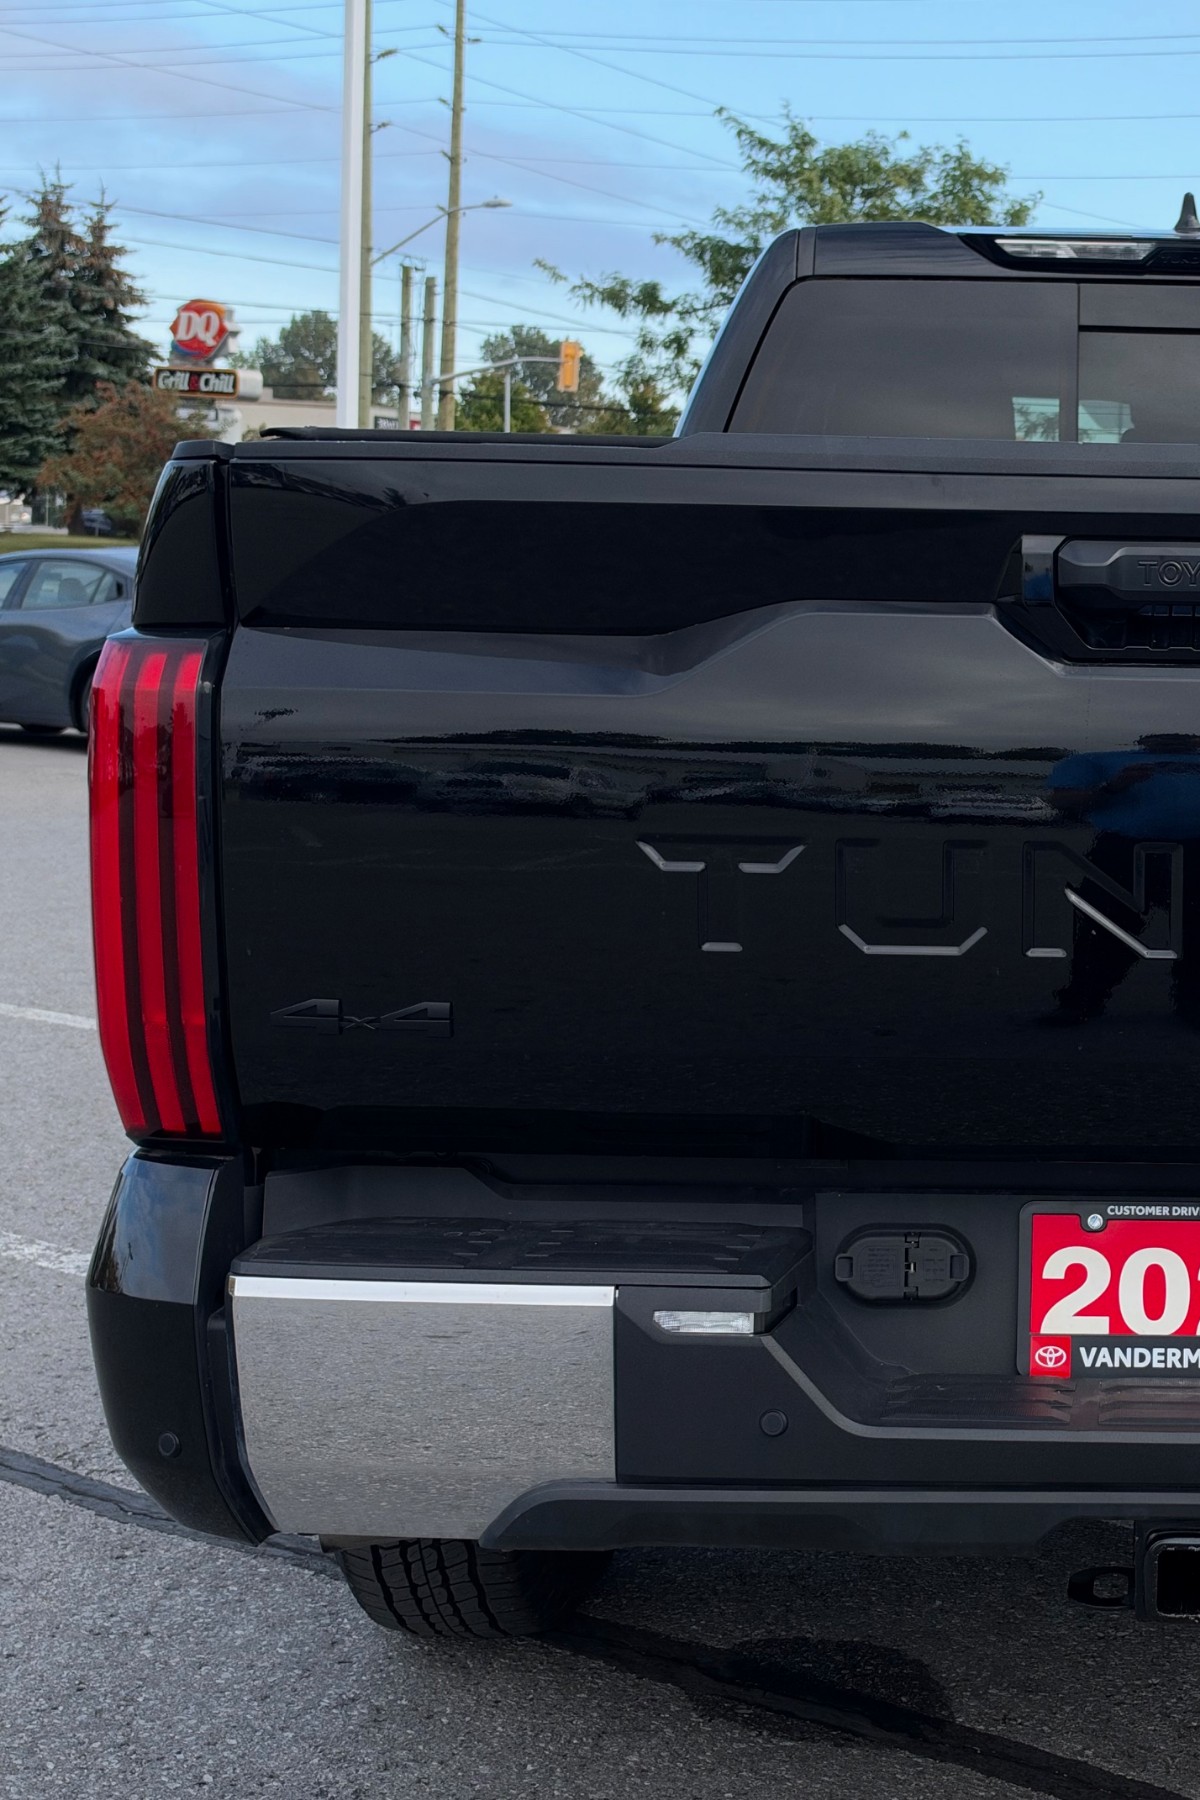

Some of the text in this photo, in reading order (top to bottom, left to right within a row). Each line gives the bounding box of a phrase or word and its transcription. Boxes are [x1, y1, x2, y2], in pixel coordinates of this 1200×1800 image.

[175, 310, 220, 347] DQ
[157, 370, 190, 391] Grill
[200, 372, 235, 393] Chill
[1107, 1205, 1170, 1217] CUSTOMER
